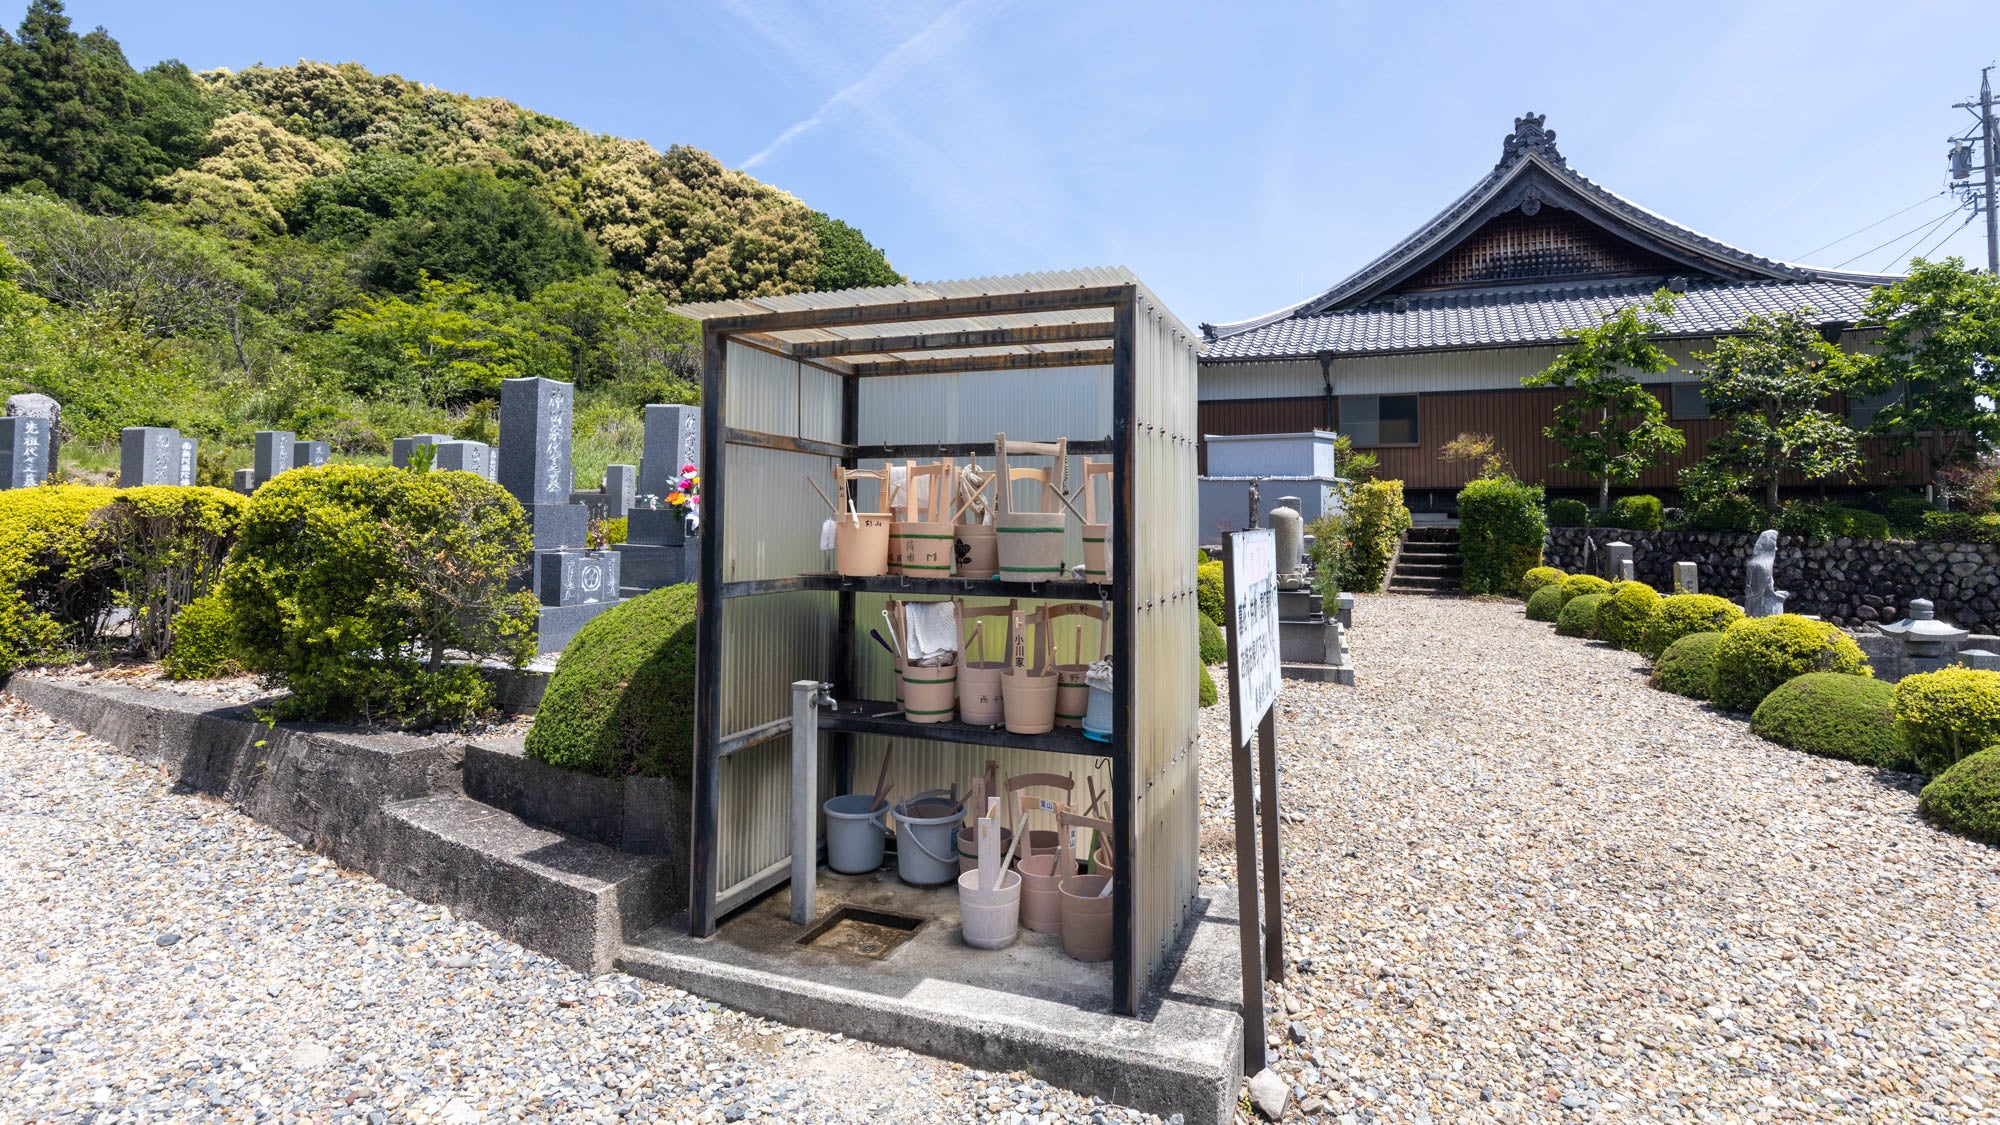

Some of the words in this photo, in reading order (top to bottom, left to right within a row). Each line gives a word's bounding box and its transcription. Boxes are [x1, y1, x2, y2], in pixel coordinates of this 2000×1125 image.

[926, 552, 938, 562] M
[1014, 634, 1025, 668] 小川家
